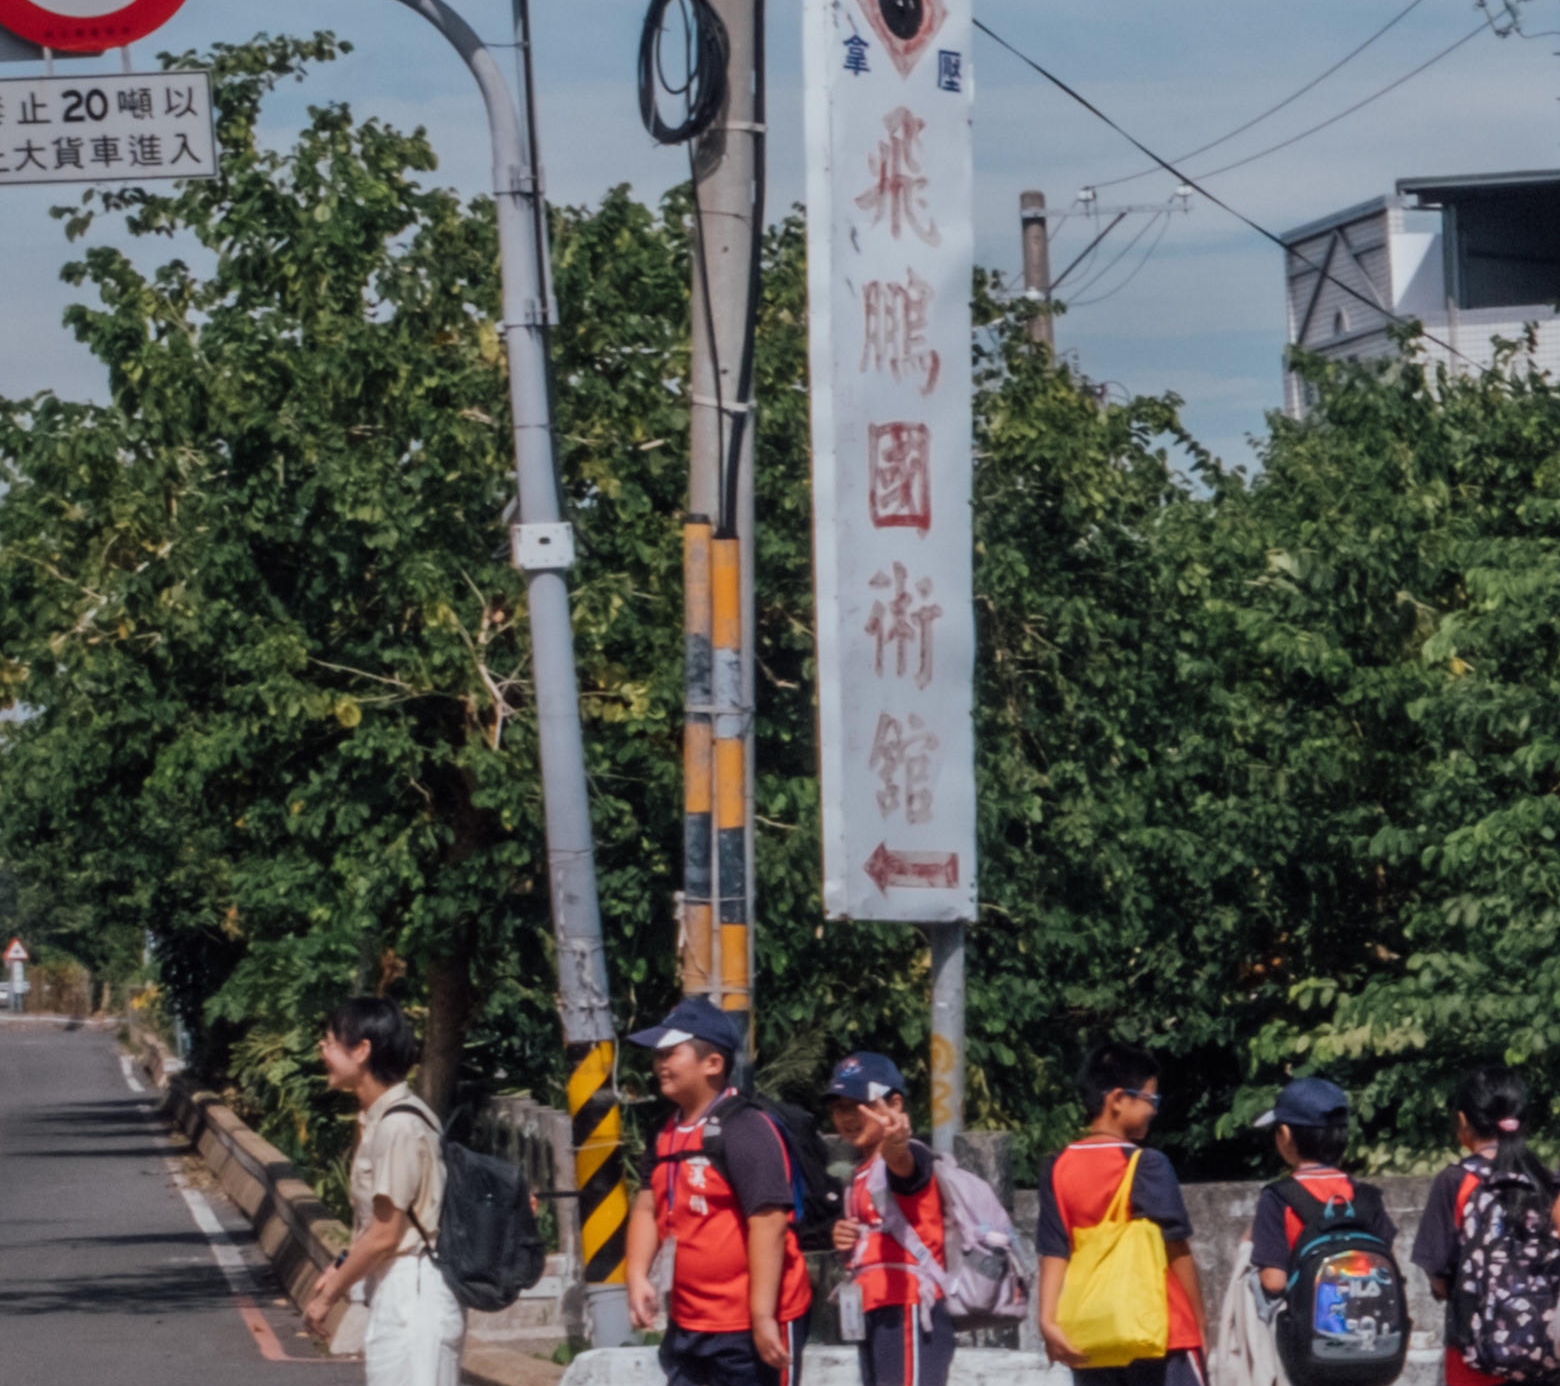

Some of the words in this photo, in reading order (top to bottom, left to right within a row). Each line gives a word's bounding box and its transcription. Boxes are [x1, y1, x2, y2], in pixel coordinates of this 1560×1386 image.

[0, 86, 197, 124] 止20噸以
[854, 105, 942, 826] 飛鵬國術館
